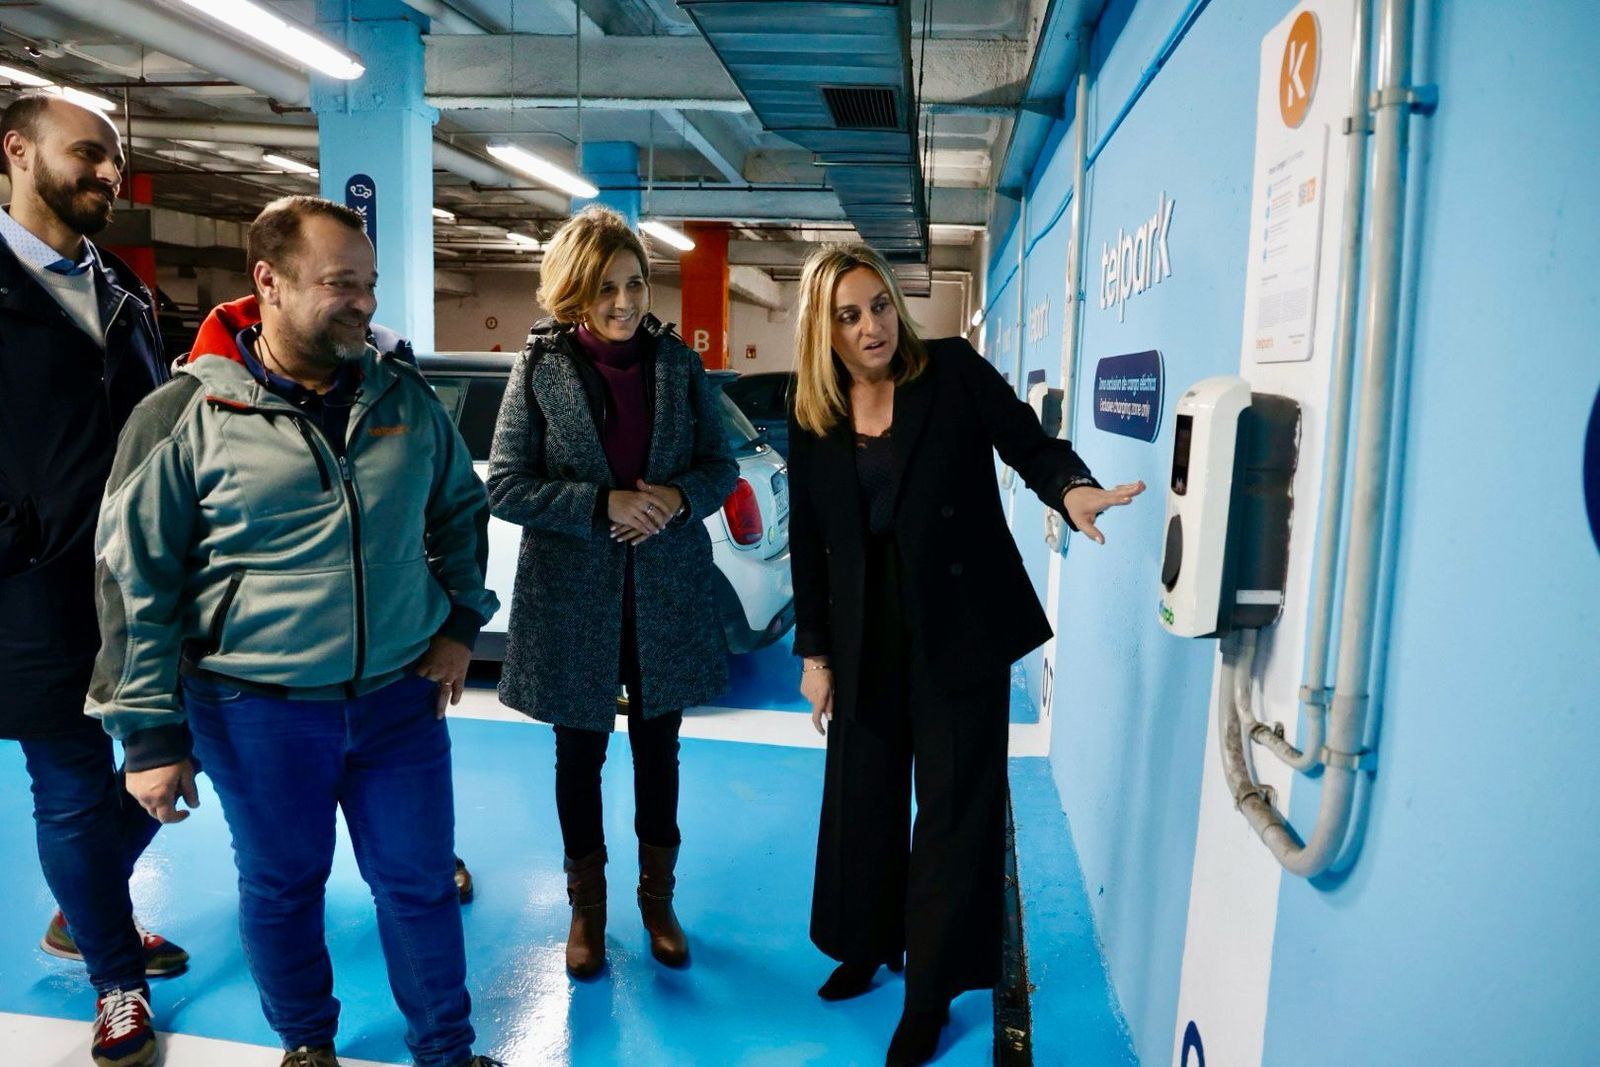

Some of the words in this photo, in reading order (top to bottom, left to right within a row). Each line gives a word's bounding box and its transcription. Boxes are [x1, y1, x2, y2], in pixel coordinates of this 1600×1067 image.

[1287, 41, 1309, 107] K
[1099, 190, 1176, 323] telpark
[694, 330, 710, 353] B
